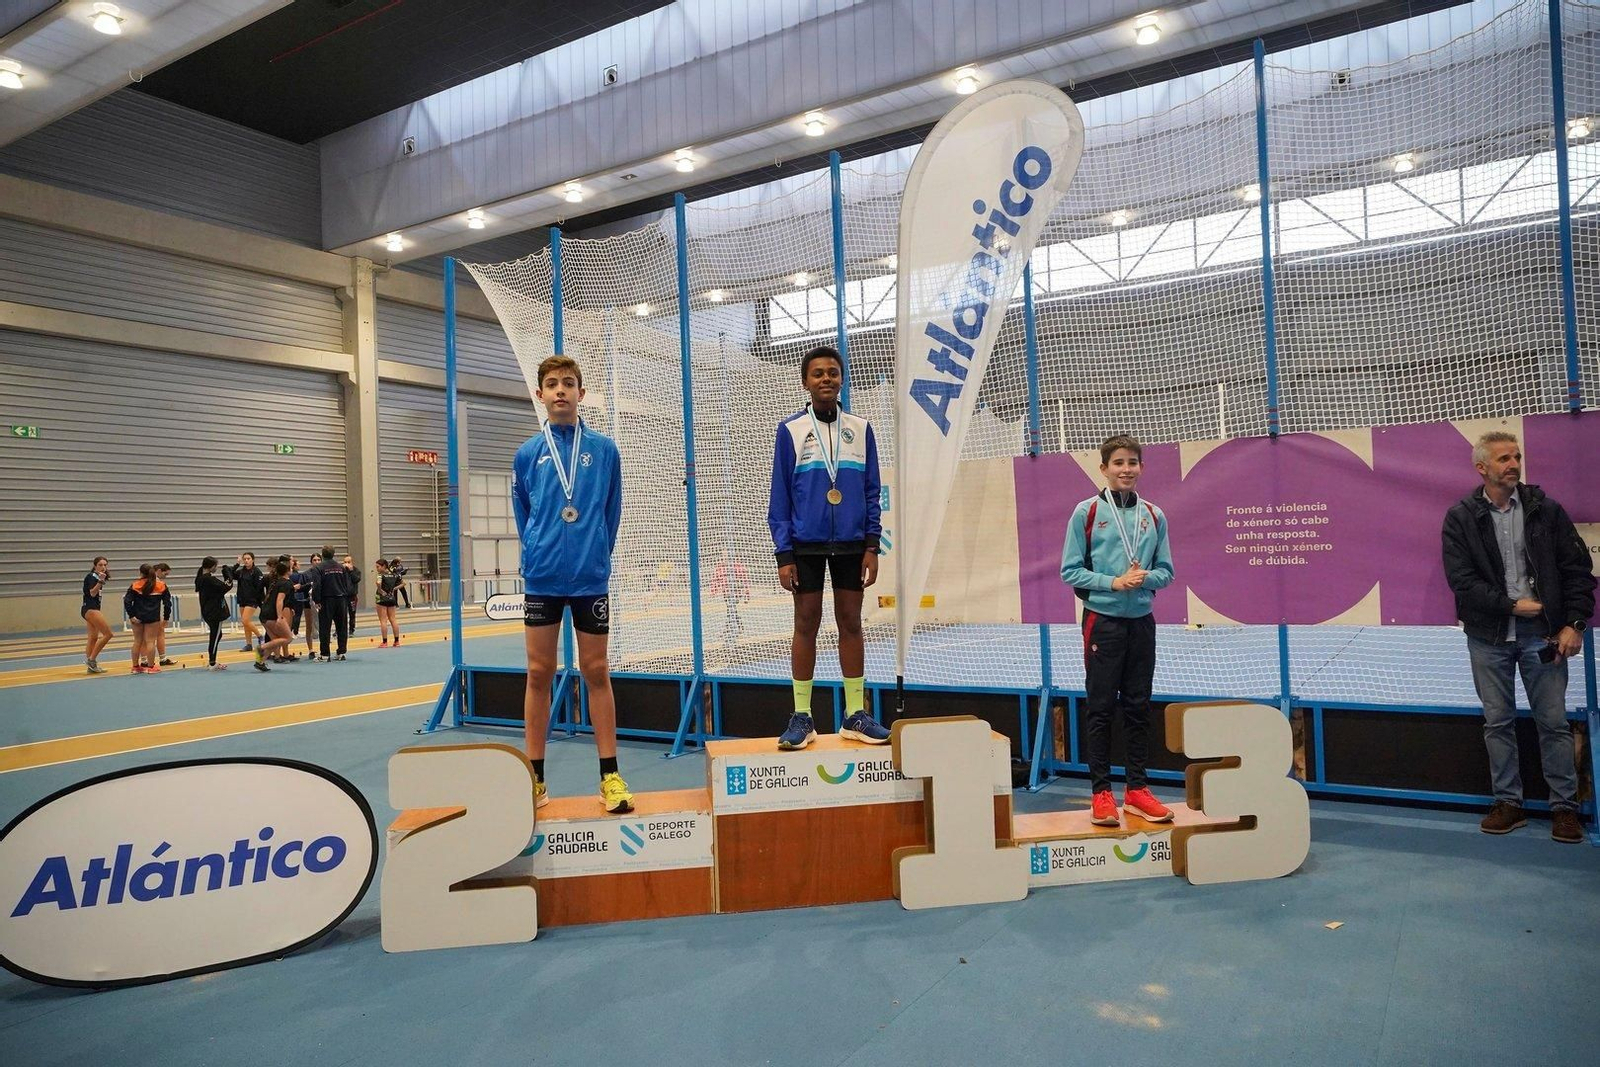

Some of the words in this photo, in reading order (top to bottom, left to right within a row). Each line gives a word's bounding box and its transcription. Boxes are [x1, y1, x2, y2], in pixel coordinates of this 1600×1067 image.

[909, 146, 1052, 437] Atlántico
[1226, 505, 1262, 515] Fronte
[1266, 503, 1273, 514] á
[1276, 501, 1328, 513] violencia
[1226, 518, 1240, 528] de
[1243, 515, 1281, 527] xénero
[1284, 515, 1298, 526] só
[1301, 515, 1329, 525] cabe
[1236, 530, 1263, 541] unha
[1267, 529, 1320, 540] resposta.
[1225, 544, 1247, 554] Sen
[1250, 542, 1289, 554] ningún
[1292, 541, 1333, 552] xénero
[1249, 556, 1263, 566] de
[1266, 555, 1309, 566] dúbida.
[490, 602, 525, 612] Atlánt
[750, 766, 786, 777] XUNTA
[858, 760, 893, 772] GALICI
[750, 779, 763, 790] DE
[765, 776, 809, 788] GALICIA
[858, 770, 913, 783] SAUDABL
[1166, 701, 1311, 886] 3
[893, 717, 1029, 911] 1
[648, 820, 696, 831] DEPORTE
[548, 831, 594, 844] GALICIA
[648, 830, 692, 840] GALEGO
[381, 746, 538, 954] 2
[548, 841, 608, 855] SAUDABLE
[1052, 846, 1085, 858] XUNTA
[1052, 859, 1064, 869] DE
[1066, 856, 1106, 868] GALICIA
[10, 826, 347, 917] Atlántico
